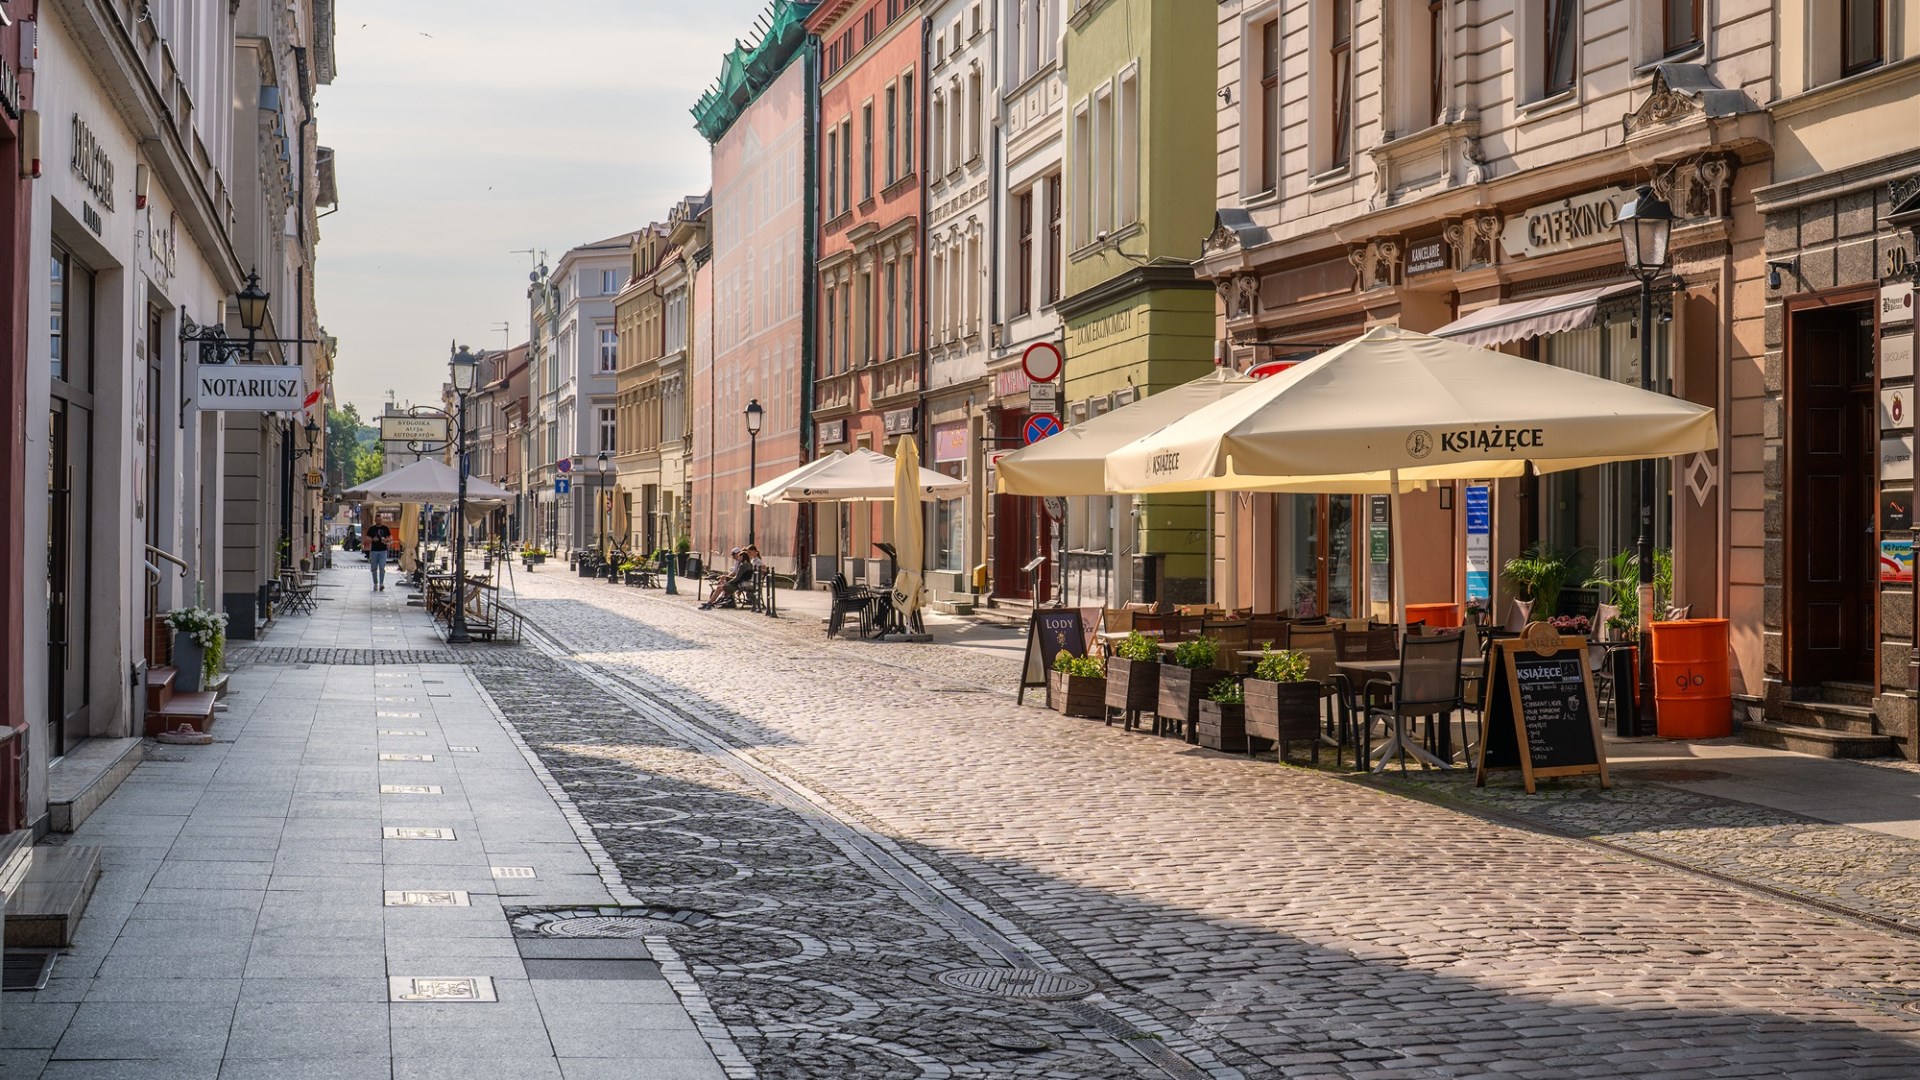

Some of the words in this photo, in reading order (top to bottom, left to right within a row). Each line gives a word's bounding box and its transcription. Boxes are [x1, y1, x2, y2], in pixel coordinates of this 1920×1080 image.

[1411, 243, 1440, 262] KANCELARIE
[1885, 245, 1905, 277] 30
[201, 378, 298, 397] NOTARIUSZ
[1441, 424, 1544, 453] KSIĄŻĘCE
[1152, 449, 1180, 475] KSIĄŻĘCE
[1045, 619, 1073, 629] LODY
[1517, 666, 1562, 680] KSIĄŻĘCE
[1676, 668, 1704, 691] glo
